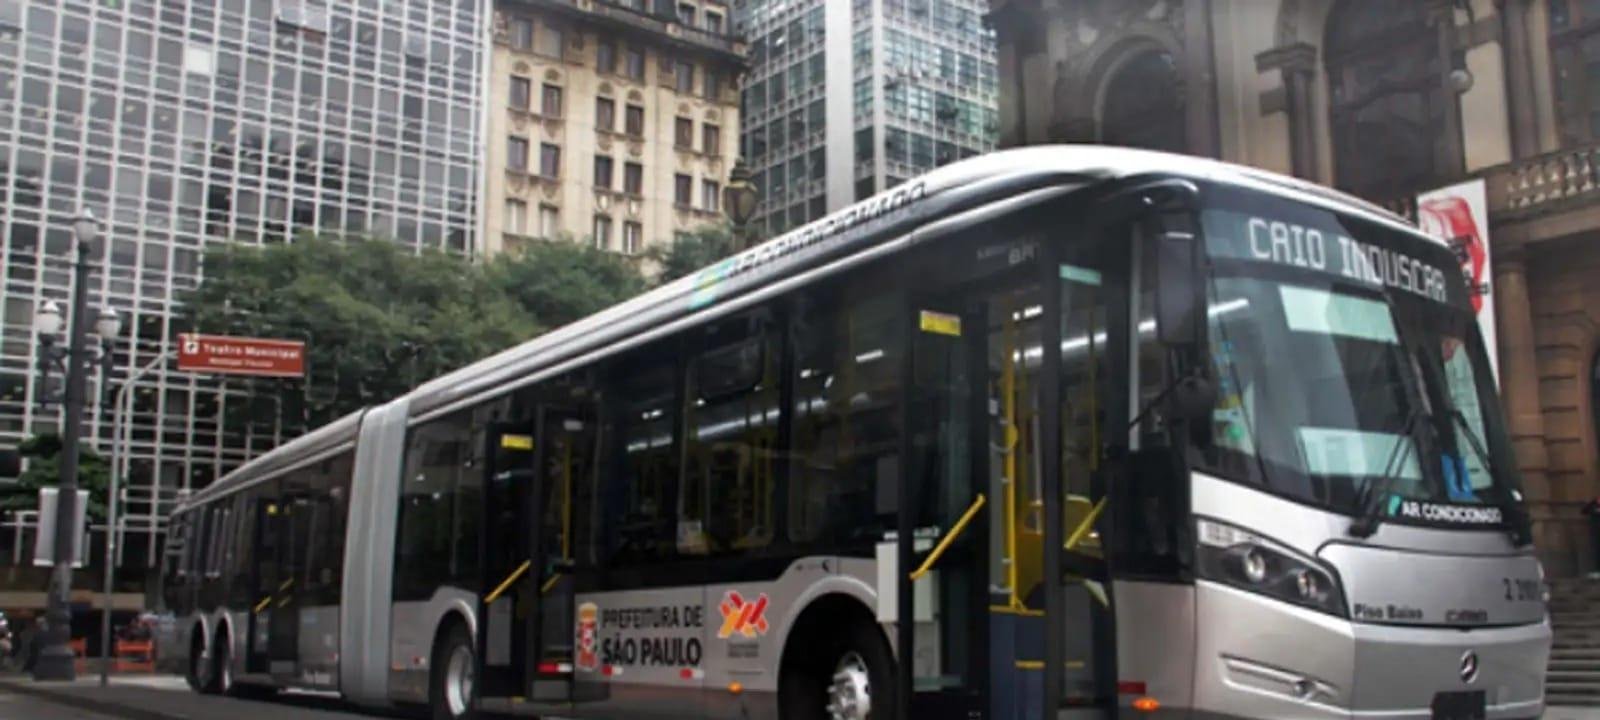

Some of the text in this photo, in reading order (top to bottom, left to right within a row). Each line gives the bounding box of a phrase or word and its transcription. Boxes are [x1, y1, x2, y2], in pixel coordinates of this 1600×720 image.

[1249, 216, 1447, 303] CAIO INDUSCAR
[1402, 501, 1502, 523] AR CONDICIONADO
[602, 606, 703, 628] PREFEITURA DE
[602, 633, 637, 665] SÃO
[640, 637, 703, 665] PAULO
